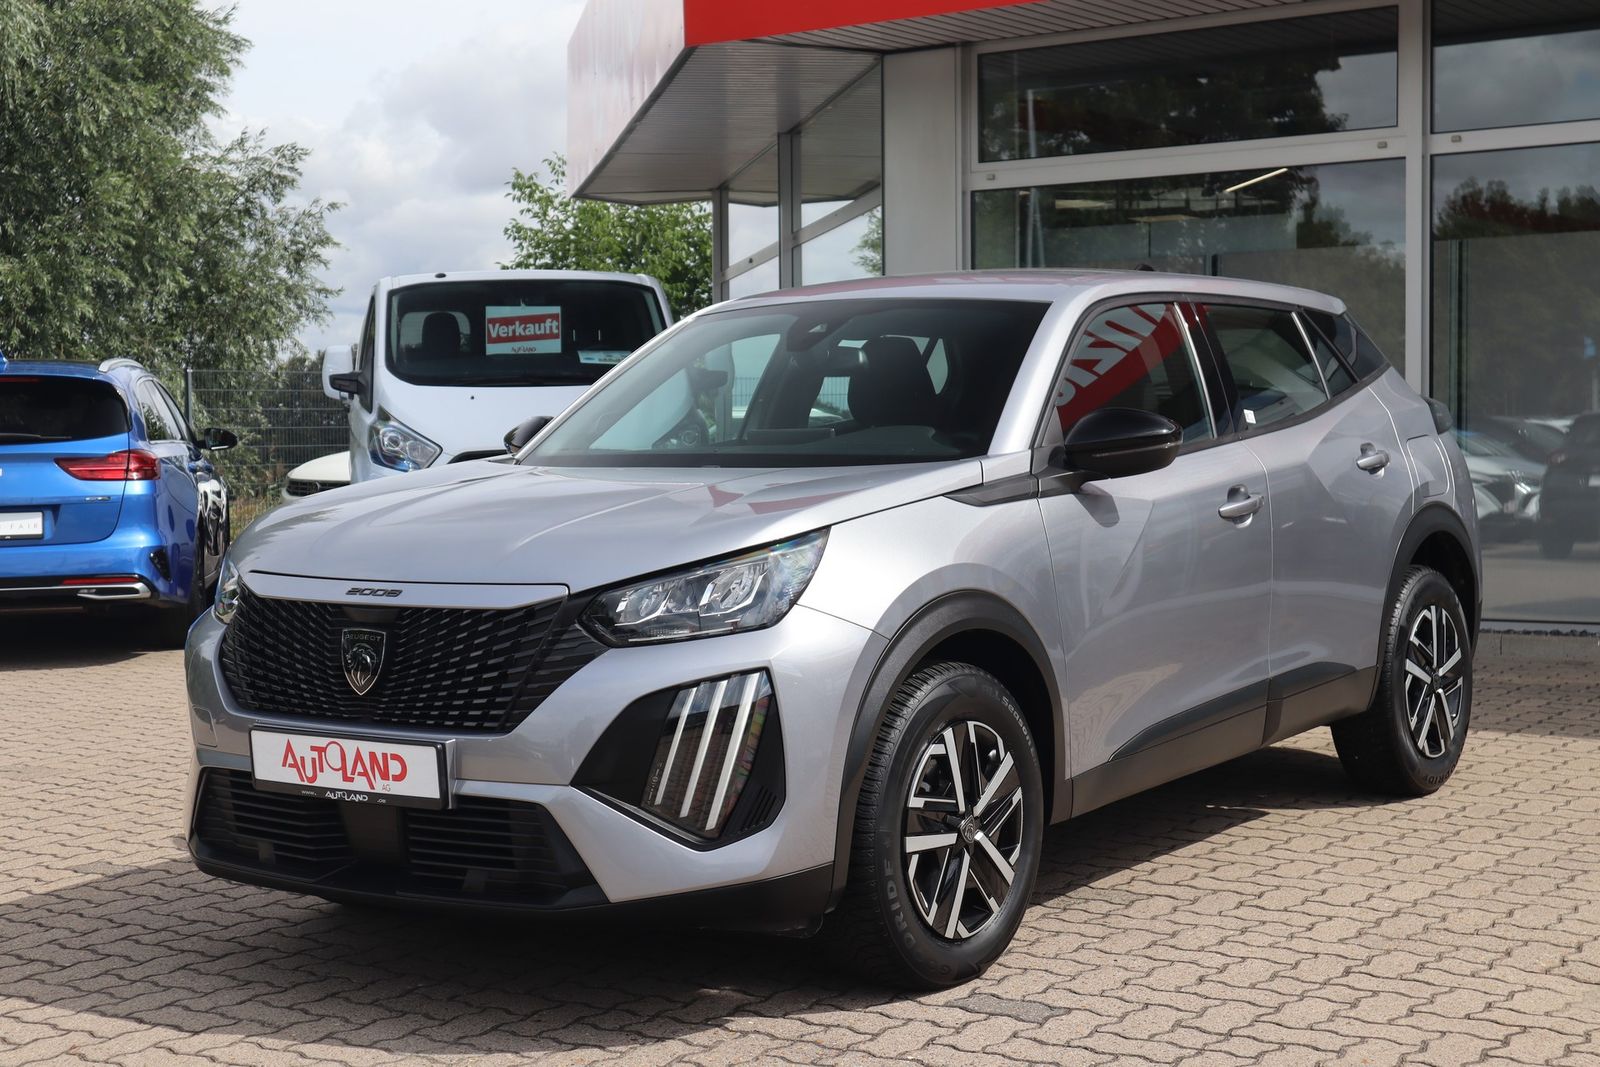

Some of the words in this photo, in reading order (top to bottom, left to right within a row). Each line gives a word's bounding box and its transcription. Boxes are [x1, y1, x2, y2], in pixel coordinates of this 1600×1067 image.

[488, 319, 559, 338] Verkauft
[345, 587, 403, 598] 2008
[344, 633, 382, 642] PEUGEOT
[281, 739, 408, 790] AUTOLAND
[381, 783, 391, 792] AG
[325, 790, 369, 802] AUTOLAND
[883, 859, 952, 975] GODRIDE
